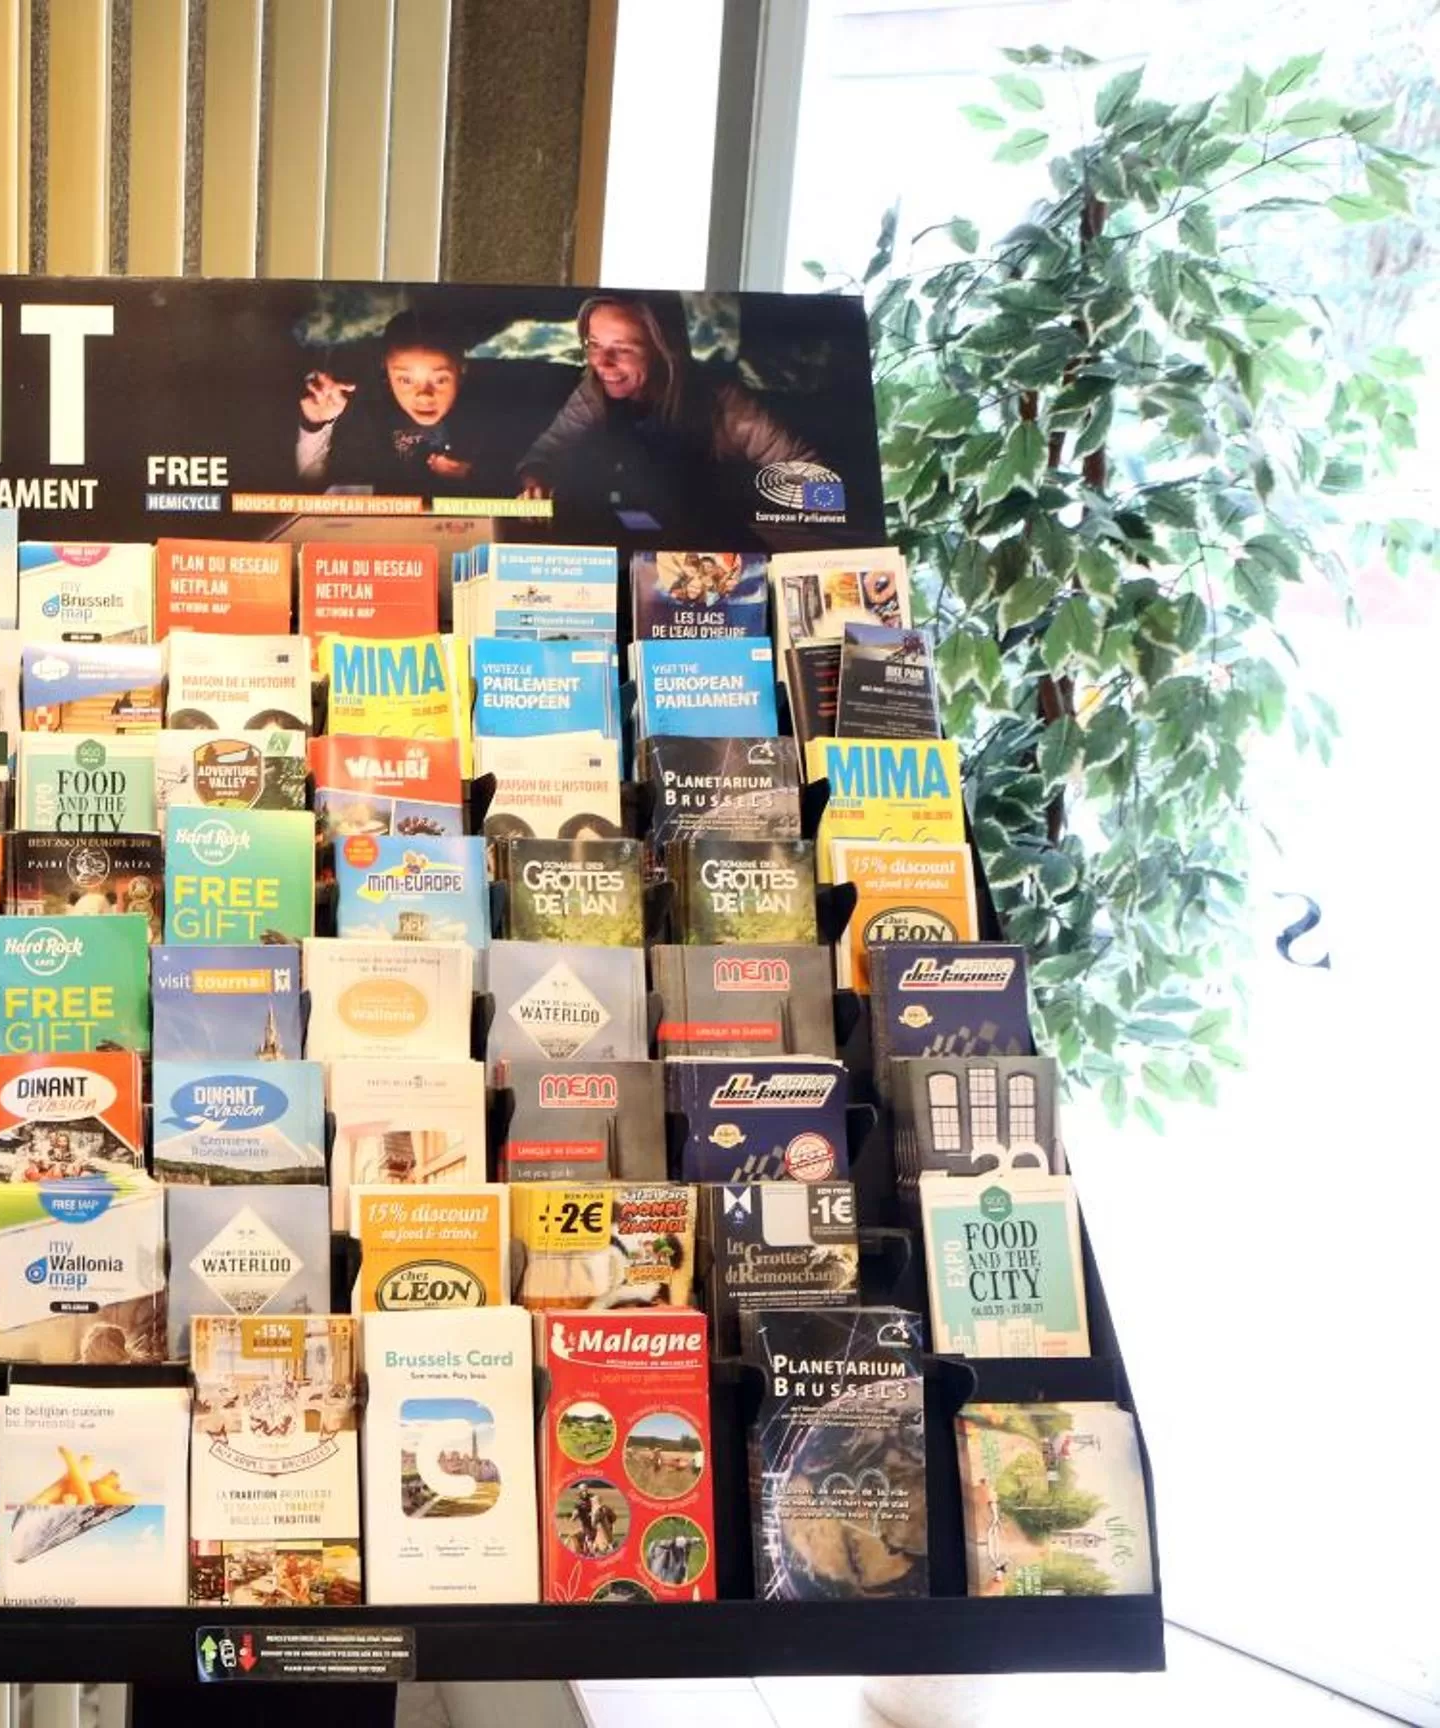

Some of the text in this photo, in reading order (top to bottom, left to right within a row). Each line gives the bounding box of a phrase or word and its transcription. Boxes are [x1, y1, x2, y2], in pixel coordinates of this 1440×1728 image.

[147, 457, 228, 486] FREE
[148, 495, 219, 510] HEMICYCLE
[234, 495, 421, 513] HOUSE OF EUROPEAN HISTORY
[172, 555, 279, 574] PLAN DU RESEAU
[316, 560, 422, 577] PLAN DU RESEAU
[170, 579, 228, 596] NETPLAN
[316, 584, 372, 600] NETPLAN
[61, 593, 124, 607] Brussels
[675, 612, 724, 624] LES LACS
[652, 626, 670, 638] DE
[672, 626, 698, 638] L'EAU
[333, 643, 446, 696] MIMA
[652, 664, 699, 674] VISIT THE
[483, 677, 580, 691] PARLEMENT
[654, 676, 743, 691] EUROPEAN
[483, 694, 570, 709] EUROPÉEN
[655, 692, 758, 708] PARLIAMENT
[197, 765, 258, 777] ADVENTURE
[345, 757, 430, 780] WALIBI
[826, 745, 951, 799] MIMA
[57, 770, 126, 795] FOOD
[209, 776, 247, 788] VALLEY
[497, 779, 536, 791] MAISON
[539, 780, 553, 791] DE
[664, 771, 773, 788] PLANETARIUM
[57, 797, 126, 812] AND THE
[665, 790, 773, 807] BRUSSELS
[56, 814, 125, 832] CITY
[175, 830, 250, 849] Hard Rock
[852, 857, 956, 874] 15% discount
[523, 861, 624, 892] GROTTES
[701, 860, 798, 890] GROTTES
[174, 876, 280, 908] FREE
[172, 909, 263, 939] GIFT
[875, 926, 945, 941] LEON
[4, 937, 83, 955] Hard Rock
[159, 974, 268, 989] visit tournai
[4, 986, 114, 1018] FREE
[519, 1006, 600, 1024] WATERLOO
[4, 1021, 99, 1052] GIFT
[18, 1077, 87, 1098] DINANT
[193, 1087, 257, 1106] DINANT
[52, 1200, 76, 1210] FREE
[368, 1203, 489, 1223] 15% discount
[812, 1196, 853, 1224] -1€
[554, 1202, 603, 1233] -2€
[962, 1220, 1037, 1251] FOOD
[49, 1241, 74, 1256] my
[744, 1243, 807, 1265] Grottes
[49, 1255, 124, 1272] Wallonia
[201, 1258, 291, 1273] WATERLOO
[969, 1250, 1041, 1269] AND THE
[49, 1271, 88, 1290] map
[969, 1268, 1041, 1302] CITY
[389, 1280, 472, 1301] LEON
[578, 1328, 702, 1356] Malagne
[386, 1351, 514, 1368] Brussels Card
[773, 1355, 905, 1377] PLANETARIUM
[774, 1381, 908, 1400] BRUSSELS
